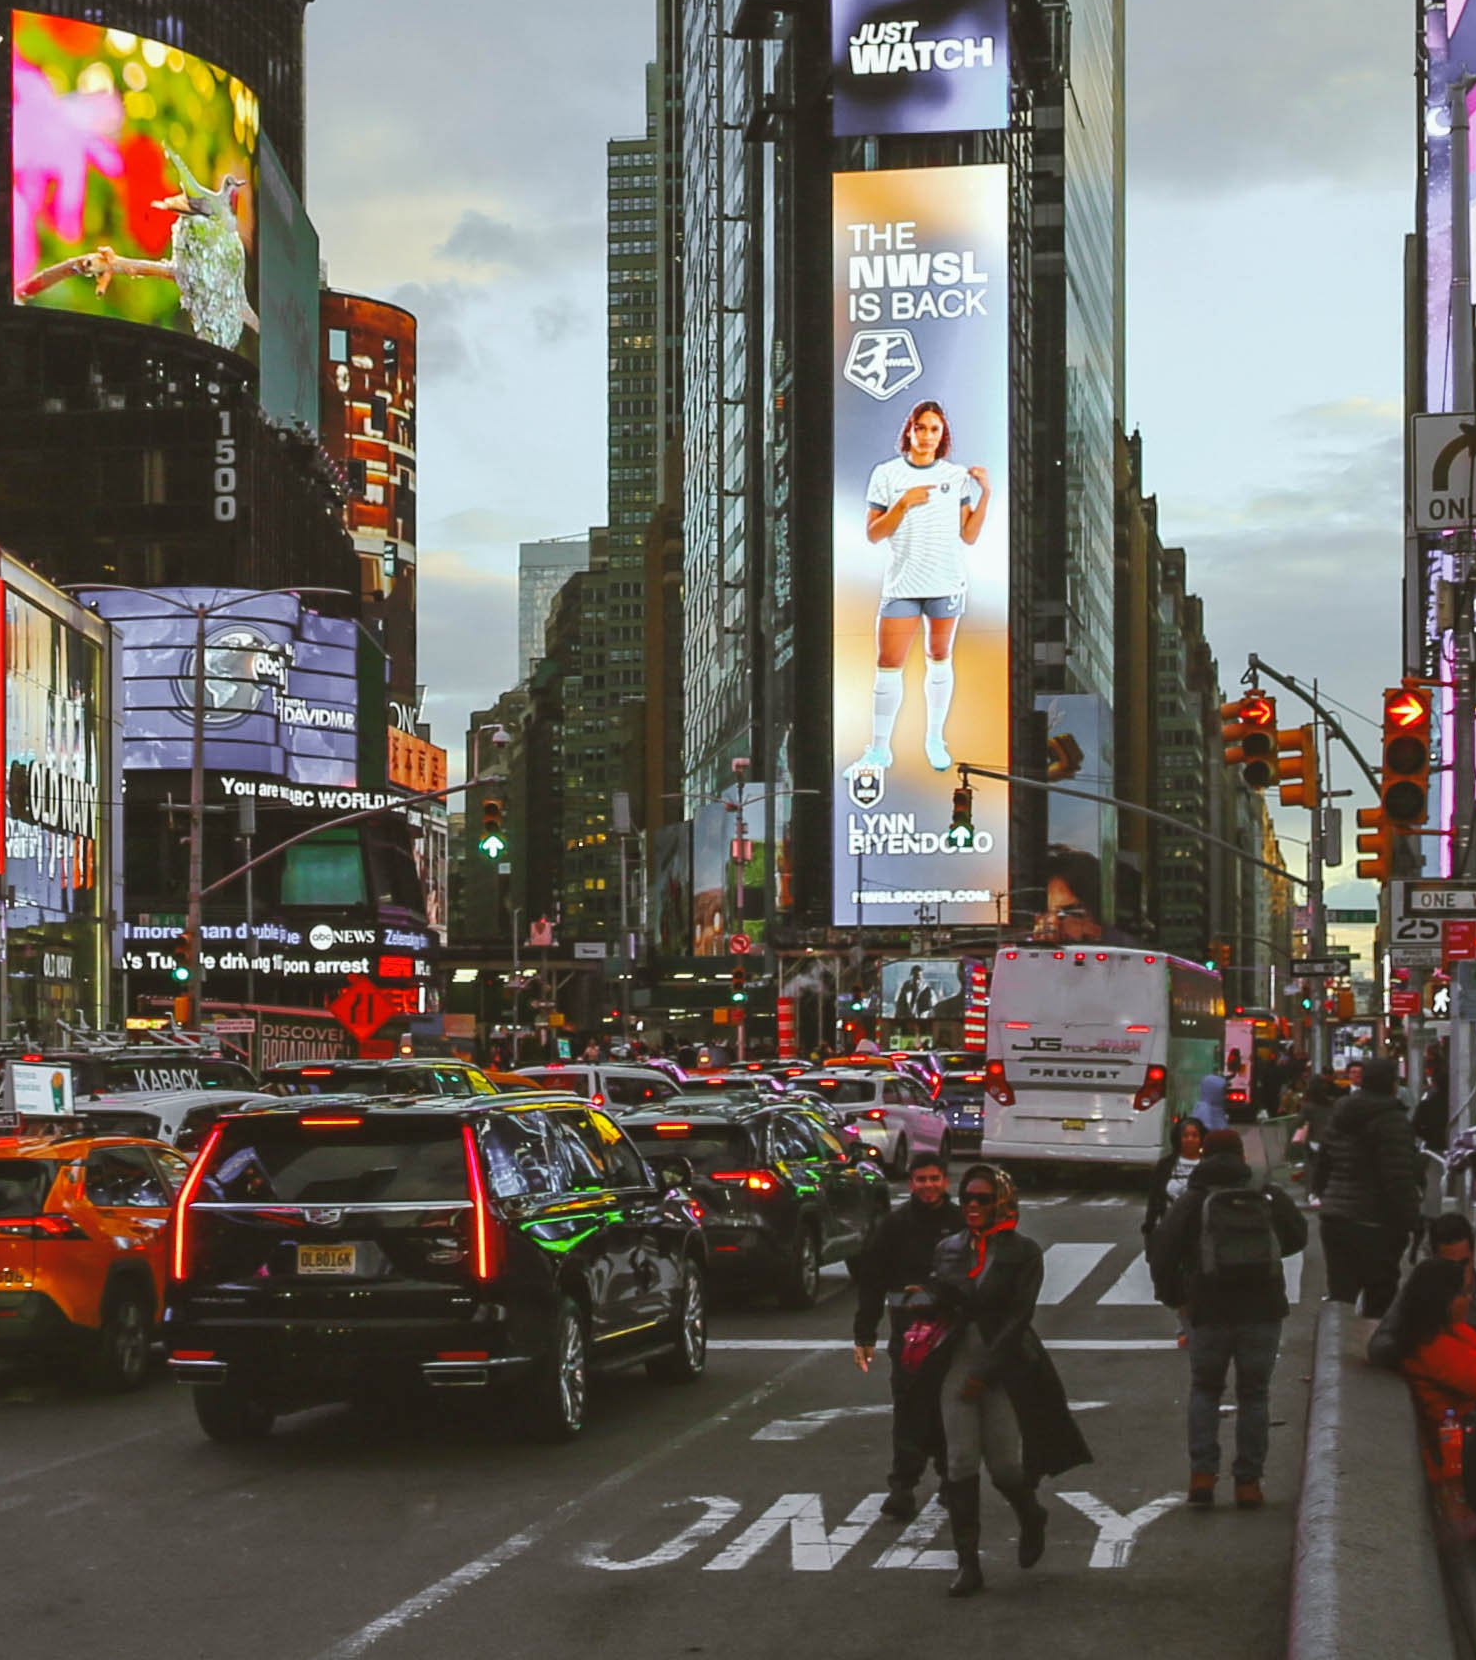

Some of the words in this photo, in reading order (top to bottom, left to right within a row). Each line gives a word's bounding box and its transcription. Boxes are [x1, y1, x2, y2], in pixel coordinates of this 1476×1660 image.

[849, 20, 919, 46] JUST
[848, 36, 994, 75] WATCH
[847, 222, 917, 252] THE
[848, 251, 989, 289] NWSL
[849, 292, 882, 323] IS
[891, 288, 989, 321] BACK
[215, 411, 237, 522] 1500
[284, 706, 331, 726] DAVID
[30, 760, 59, 828] OLD
[61, 774, 99, 840] NAVY
[221, 777, 256, 796] You
[259, 782, 278, 798] are
[318, 791, 385, 810] WORLD
[848, 813, 915, 835] LYNN
[1421, 893, 1456, 907] ONE
[133, 925, 184, 939] more
[333, 930, 376, 943] NEWS
[1397, 919, 1440, 940] 25
[314, 957, 370, 974] arrest
[1012, 1037, 1062, 1052] JG
[133, 1069, 203, 1092] KABACK
[1029, 1068, 1120, 1079] PREVOST
